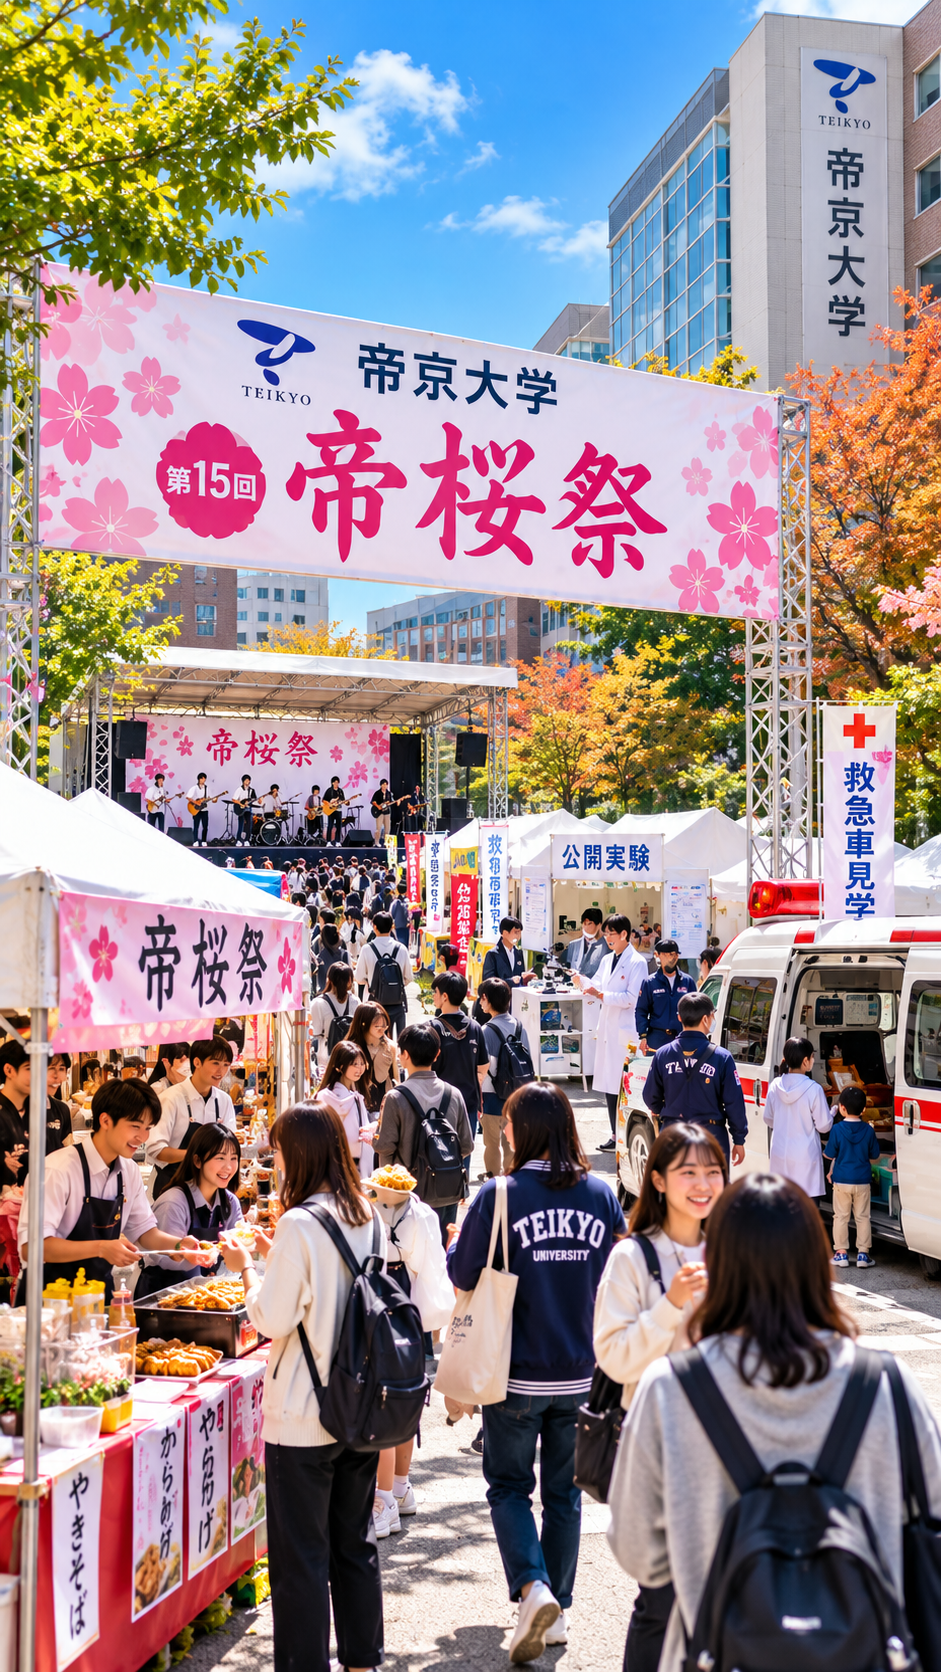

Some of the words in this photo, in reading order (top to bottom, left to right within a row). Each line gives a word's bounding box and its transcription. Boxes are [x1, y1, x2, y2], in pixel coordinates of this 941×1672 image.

[818, 115, 871, 130] TEIKYO
[827, 147, 866, 337] 帝京大学
[241, 385, 312, 406] TEIKYO
[358, 342, 558, 415] 帝京大学
[166, 460, 257, 501] 第15回
[285, 408, 668, 579] 帝桜祭
[206, 727, 318, 768] 帝桜祭
[562, 843, 650, 872] 公開実験
[843, 761, 876, 921] 救急車見学
[138, 914, 268, 1012] 帝桜祭
[512, 1208, 606, 1249] TEIKYO
[532, 1250, 590, 1262] UNIVERSITY
[69, 1472, 89, 1640] やきそば
